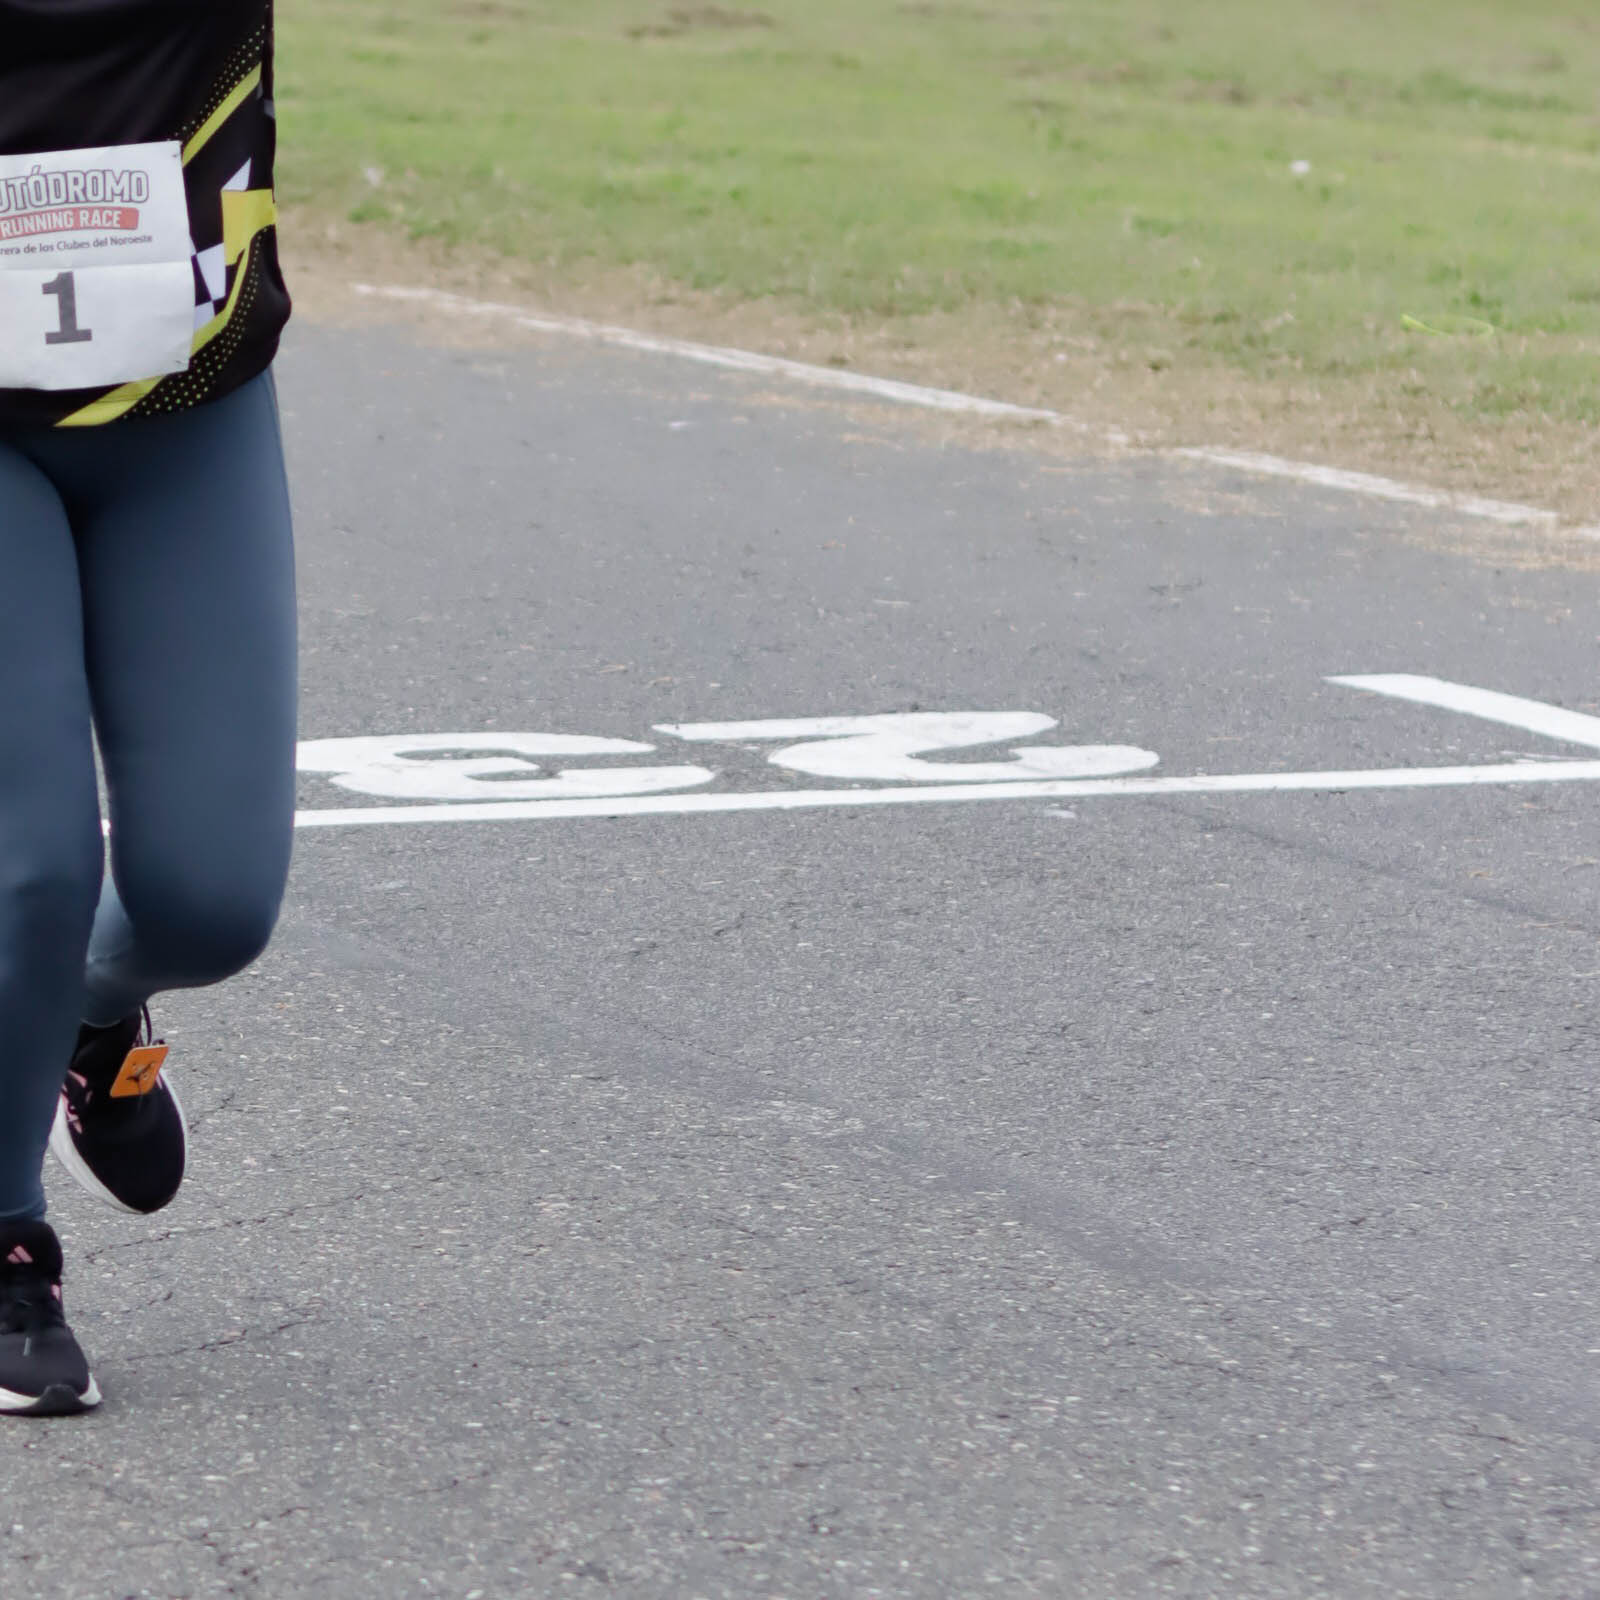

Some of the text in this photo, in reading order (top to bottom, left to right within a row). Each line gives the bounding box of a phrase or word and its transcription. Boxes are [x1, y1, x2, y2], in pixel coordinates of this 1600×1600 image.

[0, 210, 121, 239] RUNNING RACE
[23, 244, 37, 254] de
[39, 243, 55, 253] los
[56, 240, 90, 251] Clubes
[92, 237, 108, 248] del
[109, 234, 153, 247] Noroeste
[41, 271, 92, 345] 1
